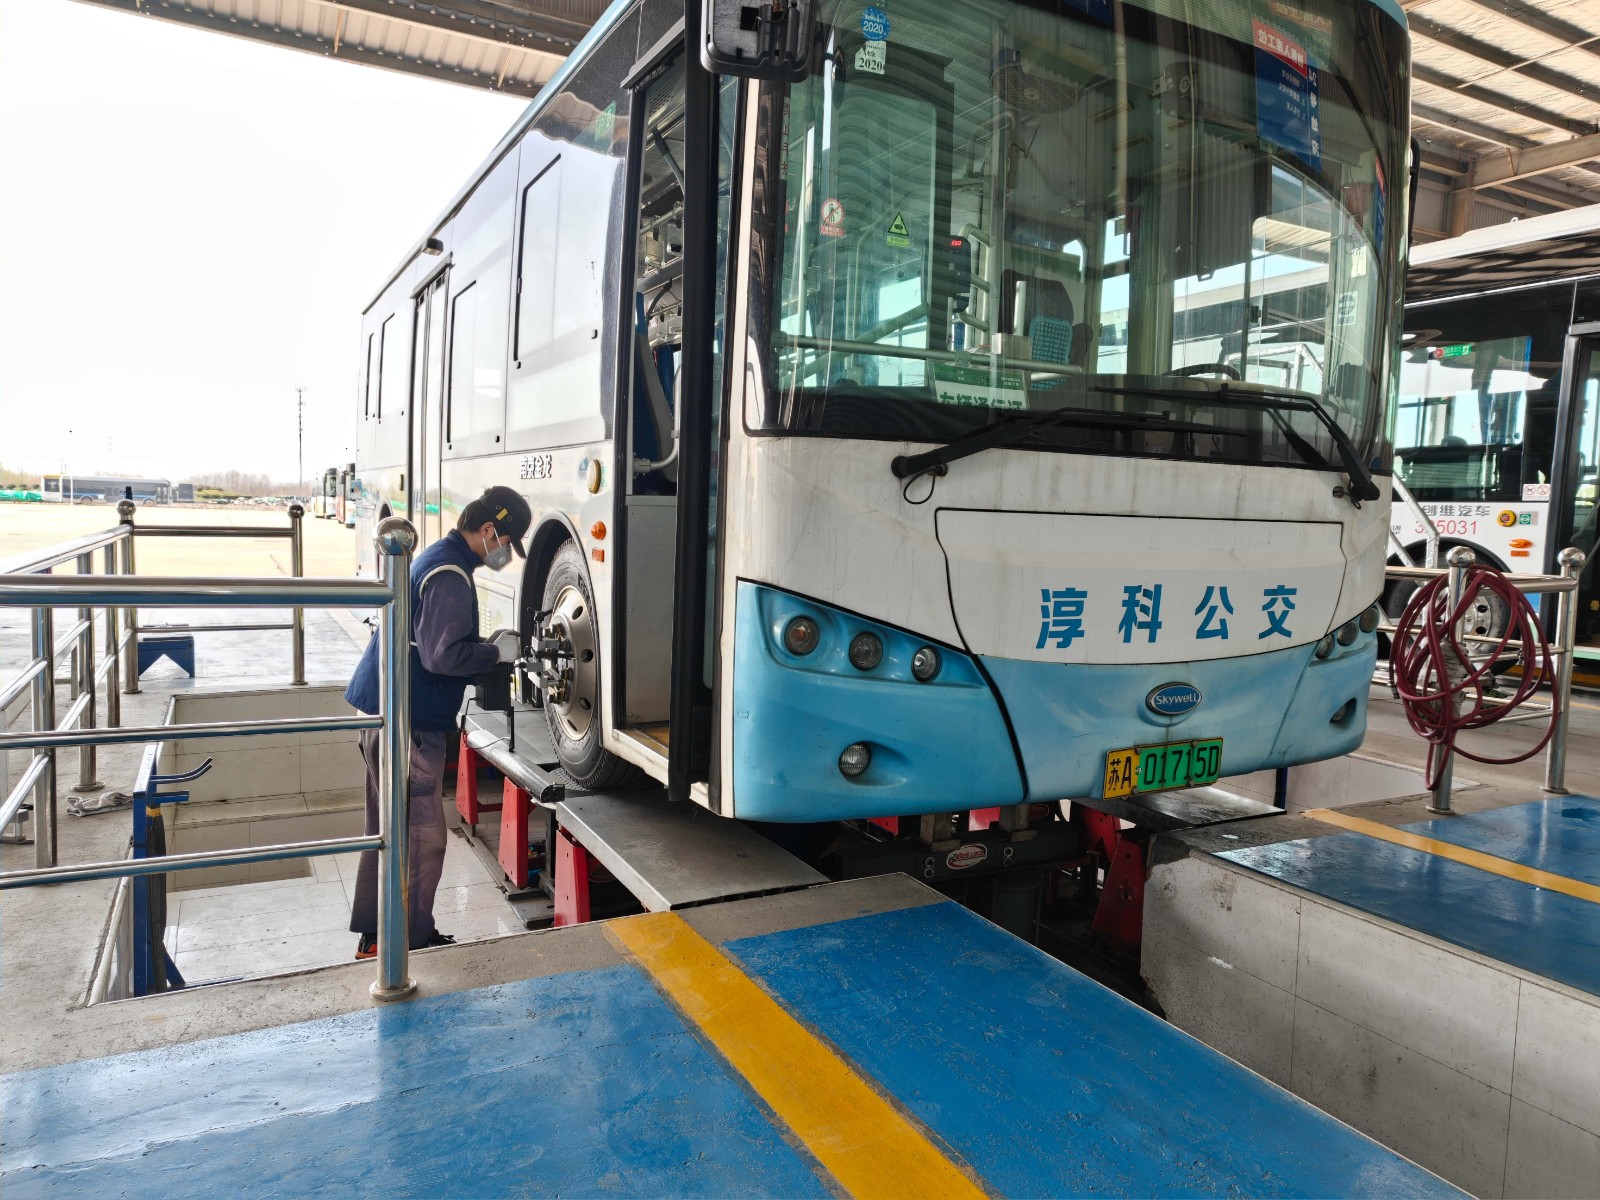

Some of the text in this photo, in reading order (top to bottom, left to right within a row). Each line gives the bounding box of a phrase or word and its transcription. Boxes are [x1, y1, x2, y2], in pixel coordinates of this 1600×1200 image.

[863, 20, 884, 35] 2020
[858, 57, 883, 71] 2020
[1414, 519, 1477, 536] 35031
[1035, 583, 1298, 649] 淳科公交
[1155, 692, 1198, 706] Skywell
